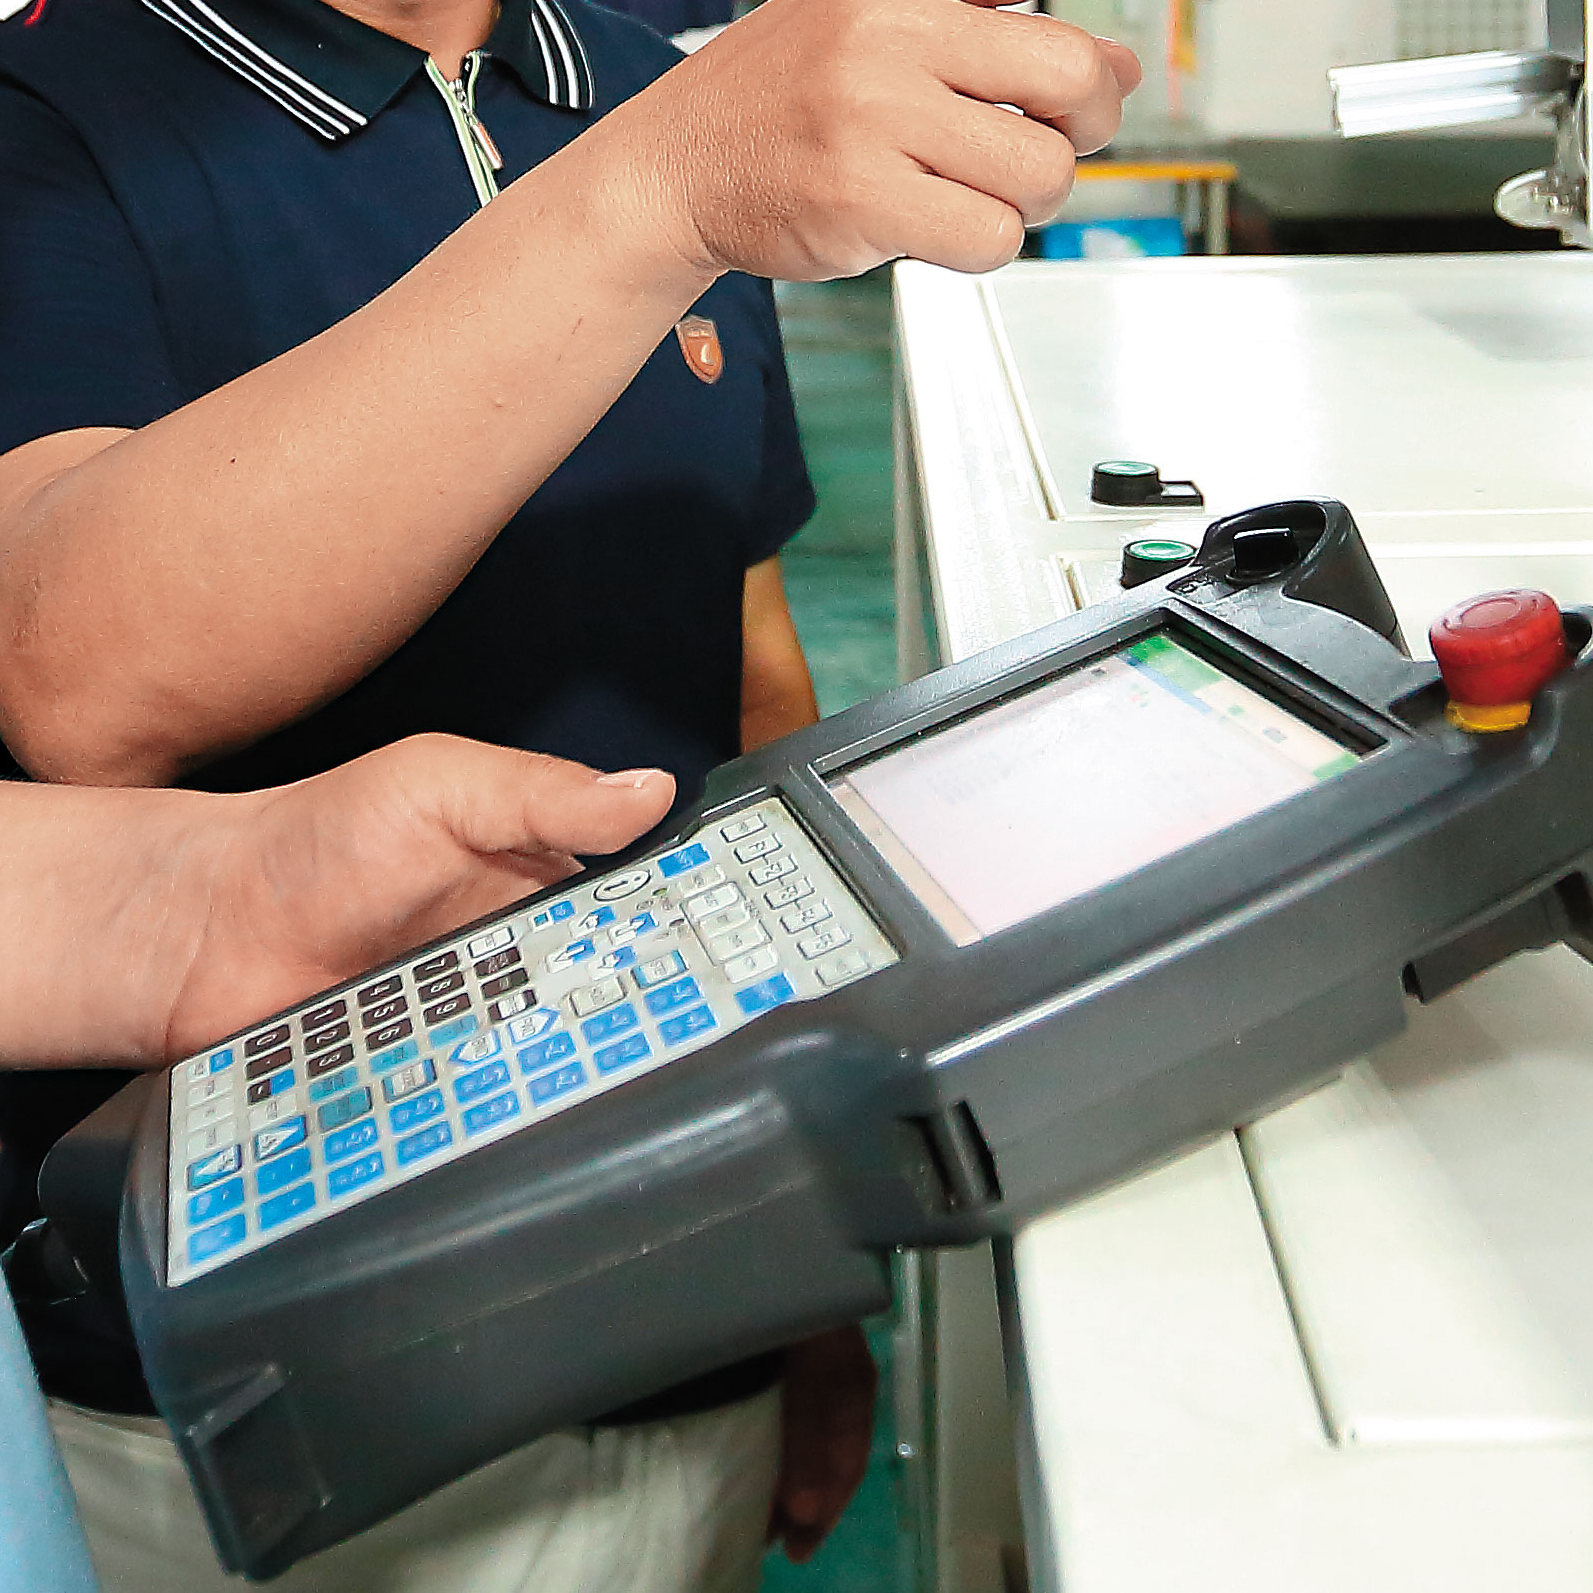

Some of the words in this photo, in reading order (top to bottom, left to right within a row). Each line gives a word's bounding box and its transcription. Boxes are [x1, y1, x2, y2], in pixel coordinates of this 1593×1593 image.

[426, 958, 445, 971] 7
[370, 983, 392, 997] 4
[430, 979, 452, 993] 8
[314, 1008, 334, 1021] 1
[374, 1004, 395, 1018] 5
[436, 1002, 457, 1015] 9
[257, 1033, 278, 1047] 0
[316, 1030, 338, 1044] 2
[378, 1027, 401, 1041] 6
[319, 1052, 342, 1067] 3
